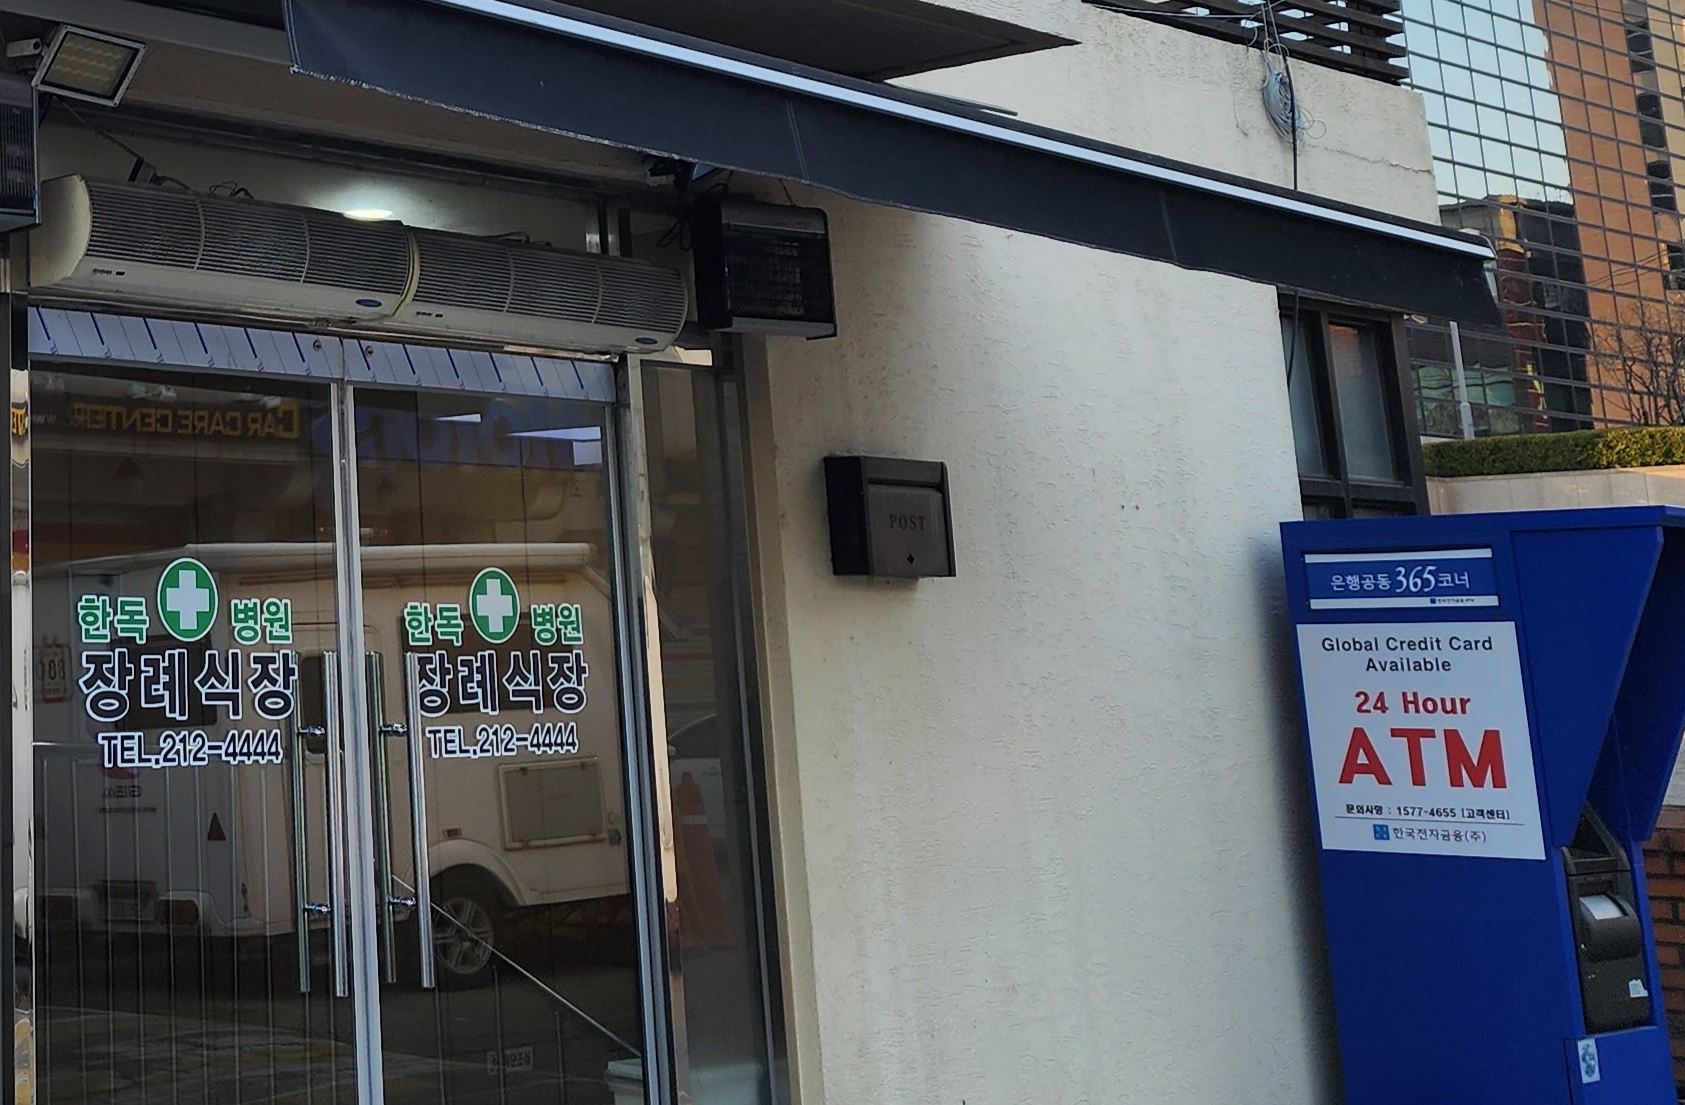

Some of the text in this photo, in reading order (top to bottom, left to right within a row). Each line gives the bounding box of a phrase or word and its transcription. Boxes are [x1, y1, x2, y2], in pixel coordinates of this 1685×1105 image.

[889, 514, 926, 531] POST
[77, 595, 293, 645] 한독 병원
[403, 601, 584, 647] 한독 병원
[1321, 636, 1493, 652] Global Credit Card
[1366, 657, 1452, 672] Available
[78, 649, 298, 722] 장례식장
[416, 650, 589, 718] 장례식장
[1354, 691, 1471, 716] 24 Hour
[98, 729, 283, 769] TEL.212-4444
[425, 722, 579, 759] TEL.212-4444
[1338, 727, 1508, 789] ATM
[1397, 806, 1456, 818] 1577-4655
[1393, 827, 1486, 843] 한국전자금융(주)
